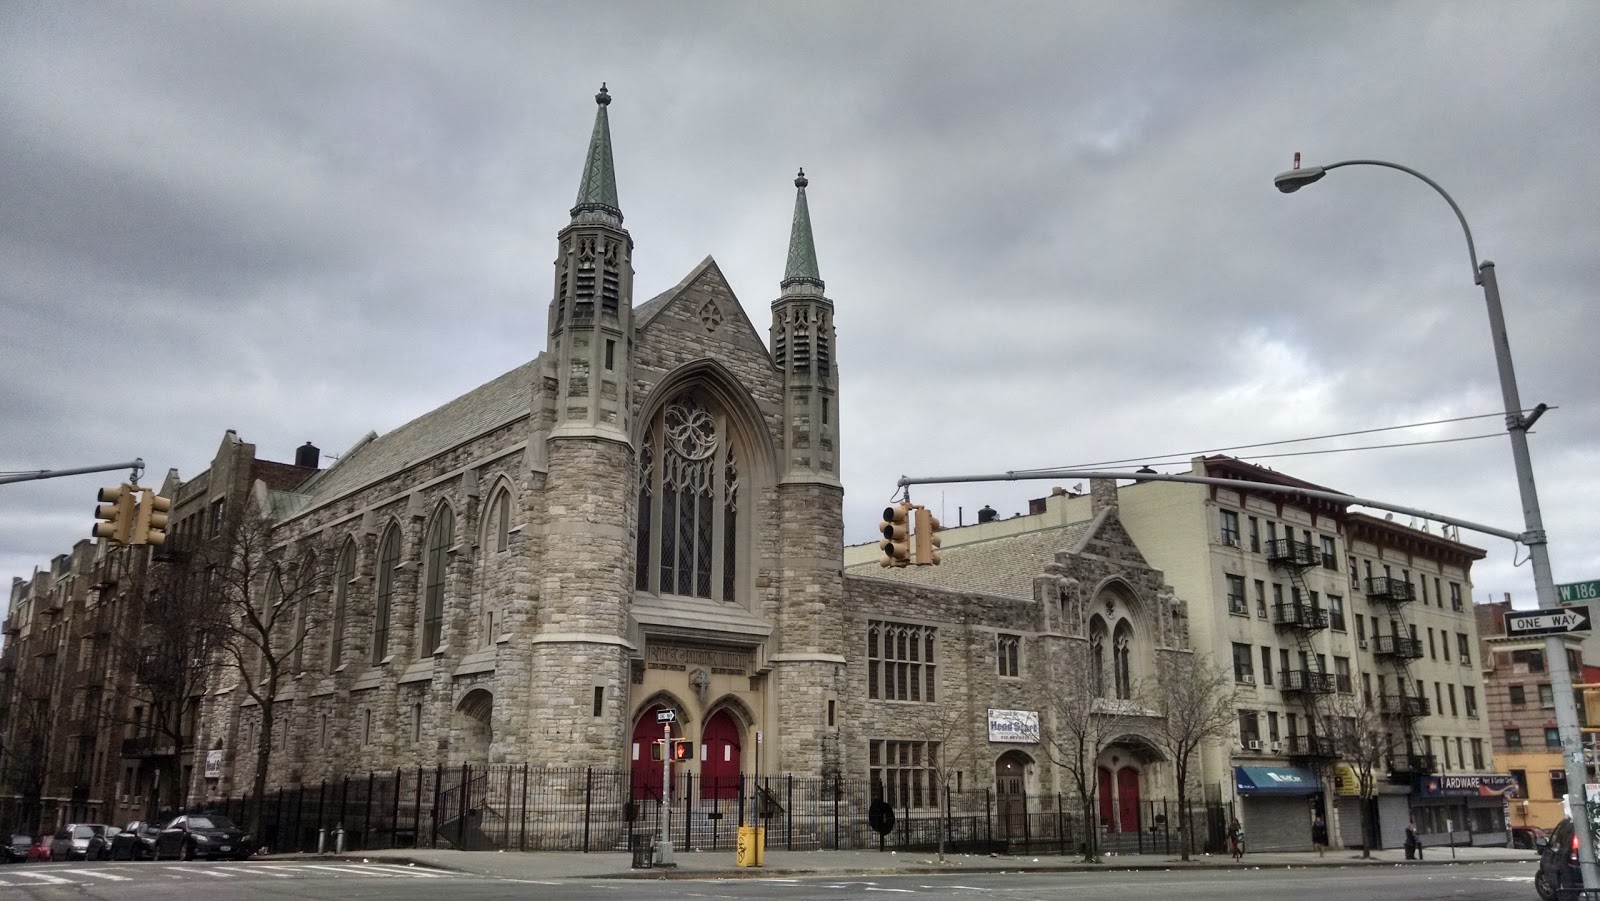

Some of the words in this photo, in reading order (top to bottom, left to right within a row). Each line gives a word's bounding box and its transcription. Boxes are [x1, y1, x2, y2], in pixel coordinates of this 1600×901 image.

[1560, 586, 1570, 600] W
[1575, 583, 1596, 599] 186
[1517, 617, 1541, 629] ONE
[1552, 615, 1577, 626] WAY
[990, 720, 1013, 731] Head
[1014, 722, 1037, 732] Start
